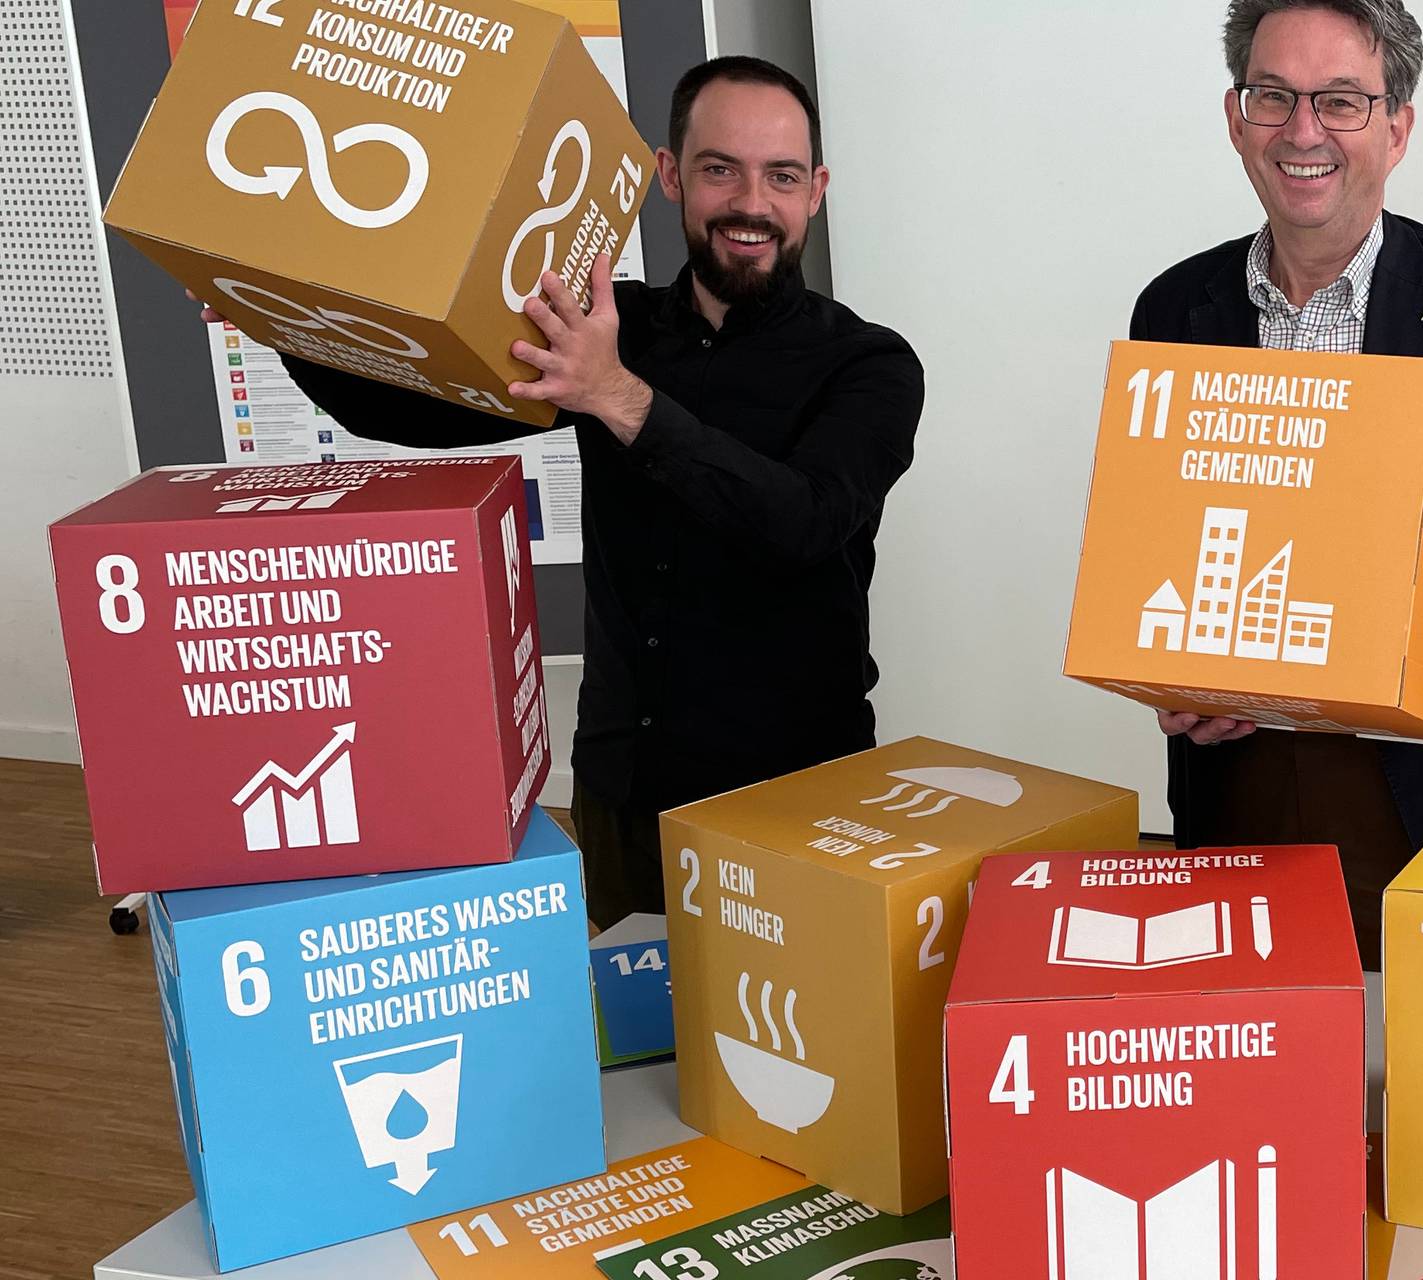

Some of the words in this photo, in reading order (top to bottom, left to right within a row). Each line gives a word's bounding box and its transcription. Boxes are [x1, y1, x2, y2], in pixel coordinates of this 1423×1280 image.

[306, 9, 415, 62] KONSUM
[413, 40, 467, 78] UND
[330, 0, 514, 54] HHALTIGE/R
[291, 44, 452, 113] PRODUKTION
[610, 153, 642, 214] 12
[447, 382, 515, 413] 12
[1126, 368, 1175, 440] 11
[1191, 371, 1352, 411] NACHHALTIGE
[1186, 407, 1274, 446] STÄDTE
[1277, 416, 1327, 449] UND
[168, 471, 219, 482] 8
[212, 479, 369, 491] WACHSTUM
[1181, 450, 1314, 489] GEMEINDEN
[165, 539, 458, 587] MENSCHENWÜRDIGE
[95, 554, 146, 634] 8
[173, 592, 275, 631] ARBEIT
[280, 589, 341, 625] UND
[176, 629, 391, 674] WIRTSCHAFTS-
[182, 675, 351, 718] WACHSTUM
[807, 835, 865, 857] KEIN
[812, 816, 897, 844] HUNGER
[718, 858, 755, 898] KEIN
[868, 841, 942, 870] 2
[1011, 860, 1052, 889] 4
[1081, 854, 1265, 872] HOCHWERTIGE
[679, 847, 702, 917] 2
[1080, 870, 1192, 887] BILDUNG
[299, 904, 449, 963] SAUBERES
[454, 882, 568, 933] WASSER
[720, 897, 784, 946] HUNGER
[916, 895, 945, 972] 2
[220, 940, 272, 1018] 6
[303, 963, 365, 1004] UND
[371, 937, 500, 988] SANITÄR-
[609, 948, 666, 976] 14
[308, 969, 530, 1045] EINRICHTUNGEN
[1066, 1021, 1277, 1067] HOCHWERTIGE
[988, 1034, 1035, 1115] 4
[1067, 1072, 1193, 1112] BILDUNG
[512, 1154, 692, 1219] NACHHALTIGE
[525, 1190, 630, 1236] STÄDTE
[630, 1176, 686, 1207] UND
[438, 1212, 509, 1257] 11
[539, 1195, 694, 1254] GEMEINDEN
[732, 1204, 880, 1267] KLIMASCHU
[633, 1247, 719, 1280] 13
